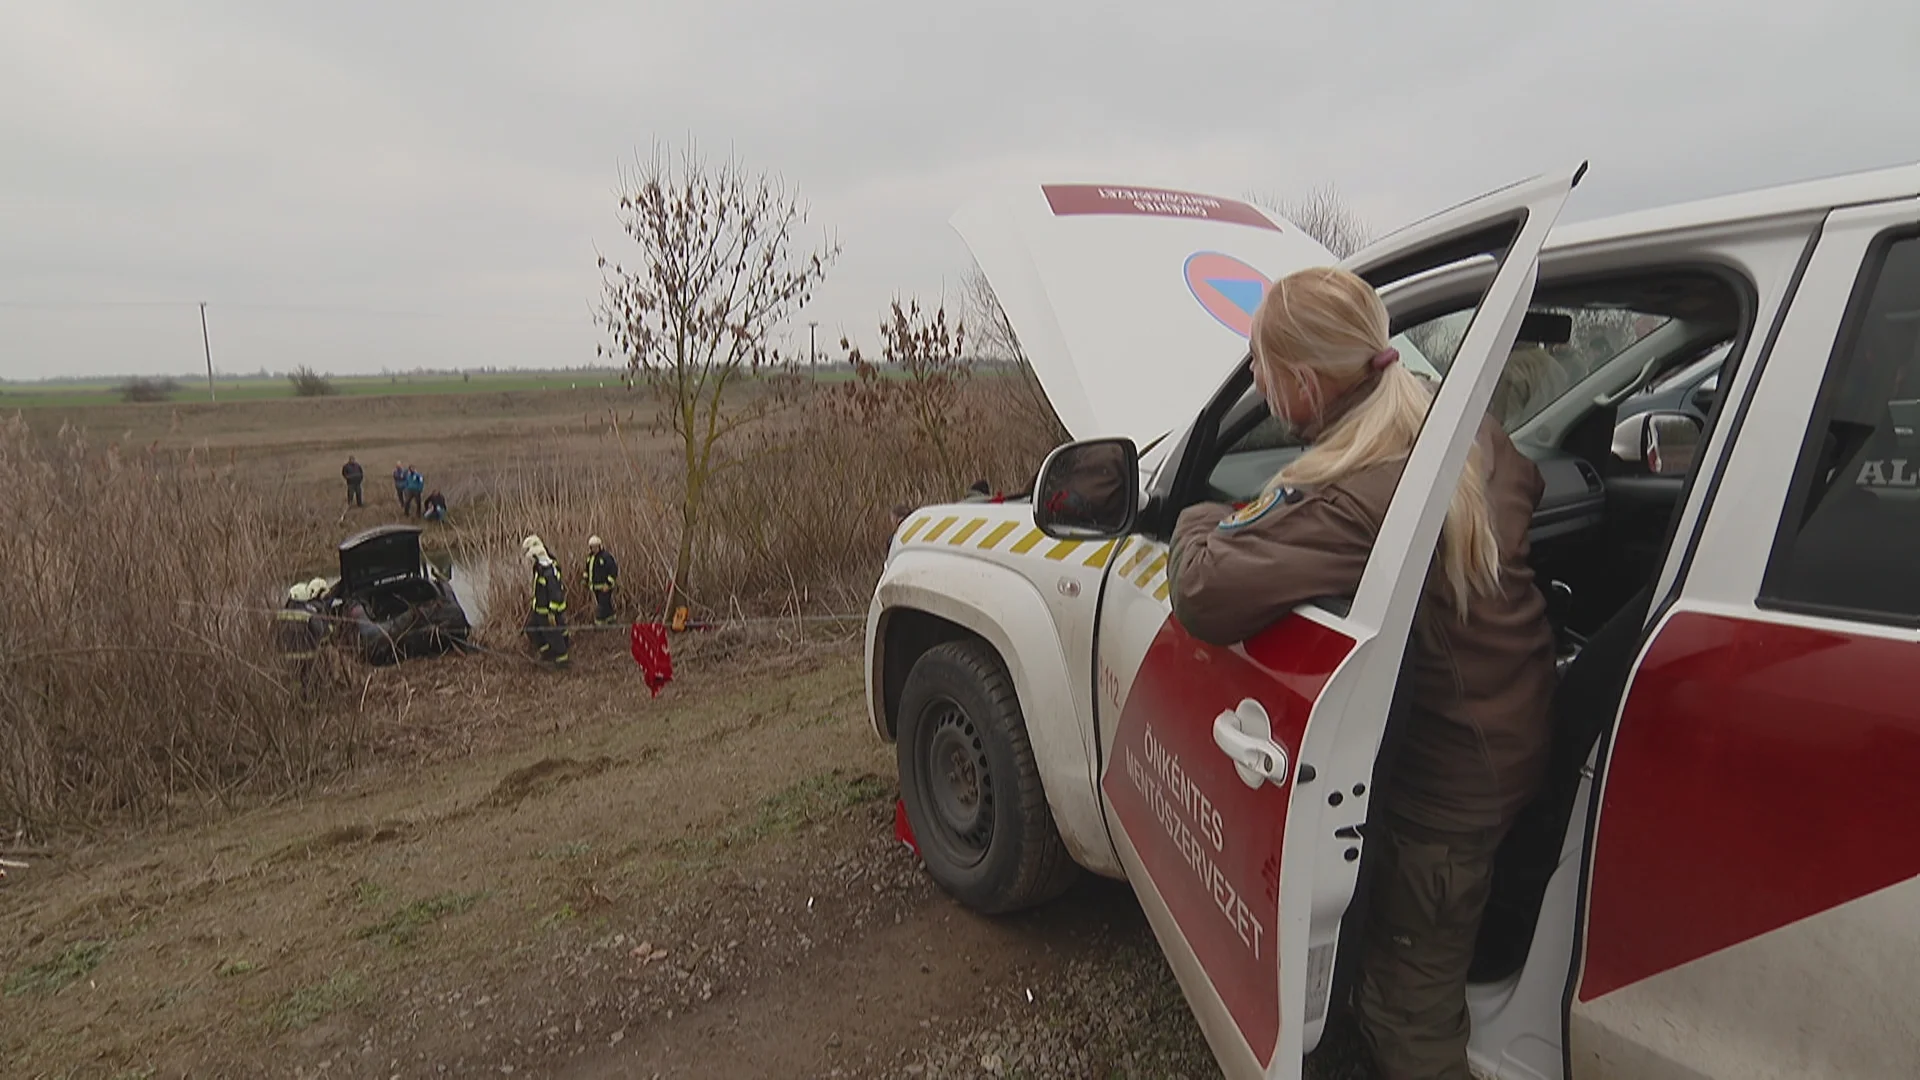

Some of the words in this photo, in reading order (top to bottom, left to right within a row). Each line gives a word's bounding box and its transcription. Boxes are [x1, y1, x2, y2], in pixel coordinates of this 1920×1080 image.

[1856, 459, 1920, 485] AL
[1105, 665, 1119, 710] 112
[1144, 721, 1224, 852] ÖNKÉNTES
[1125, 744, 1264, 960] MENTŐSZERVEZET
